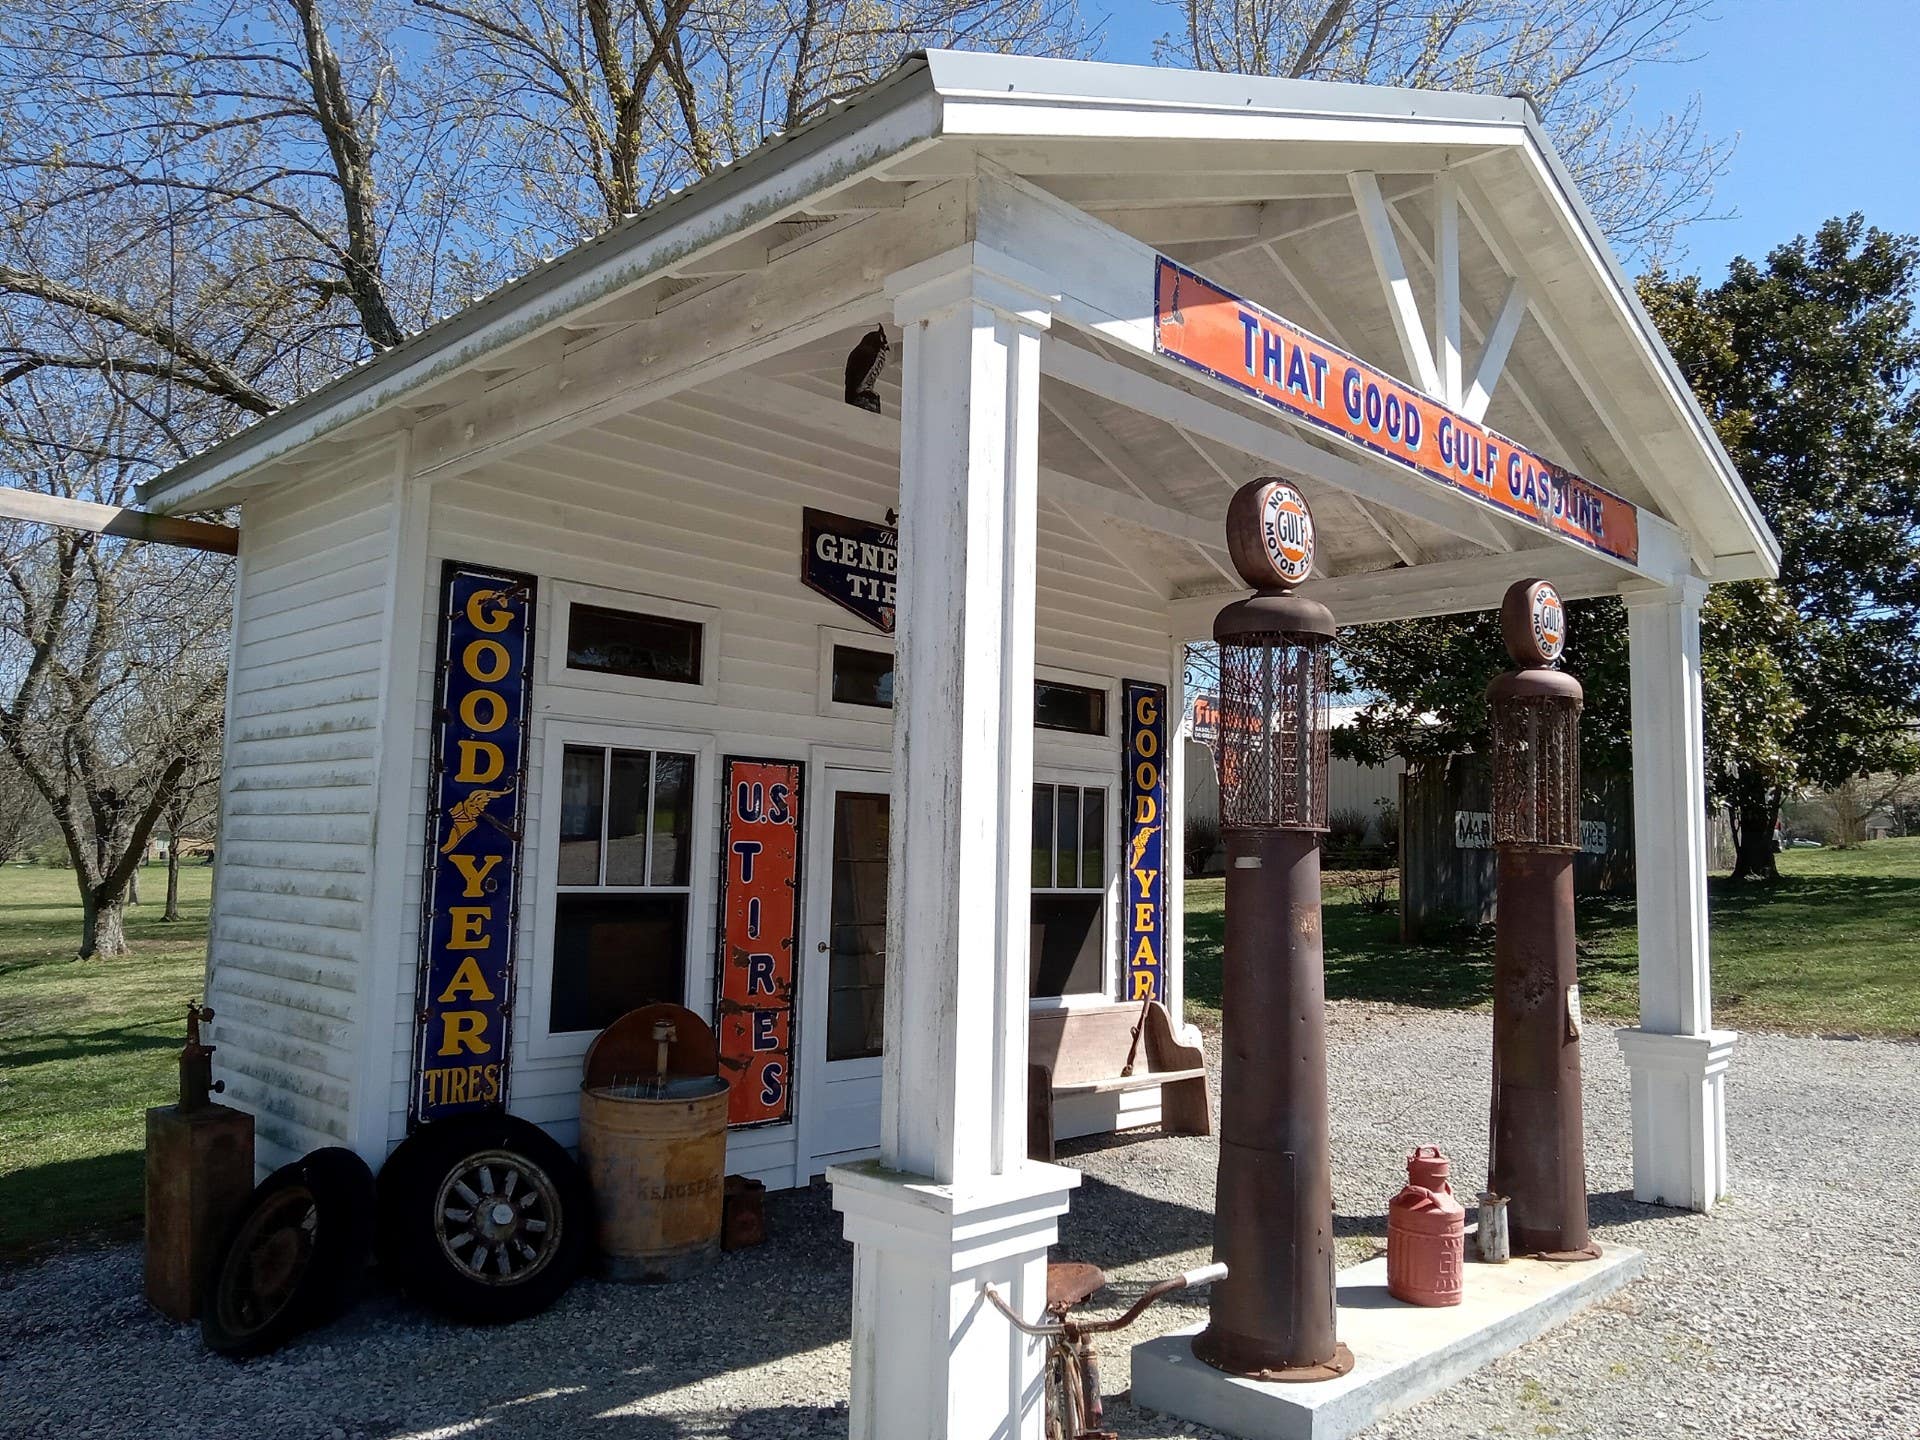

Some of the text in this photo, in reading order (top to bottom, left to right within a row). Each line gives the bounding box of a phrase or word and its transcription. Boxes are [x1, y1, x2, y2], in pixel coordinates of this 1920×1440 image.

[1238, 310, 1605, 537] THAT GOOD GULF GASOLINE
[1265, 521, 1296, 575] MOTOR
[1278, 511, 1306, 547] GULF
[816, 533, 898, 576] GENE
[846, 573, 897, 605] TIR
[1533, 613, 1553, 654] MOTOR
[737, 782, 795, 826] U.S.
[732, 841, 786, 1107] TIRES
[423, 1064, 498, 1106] TIRES
